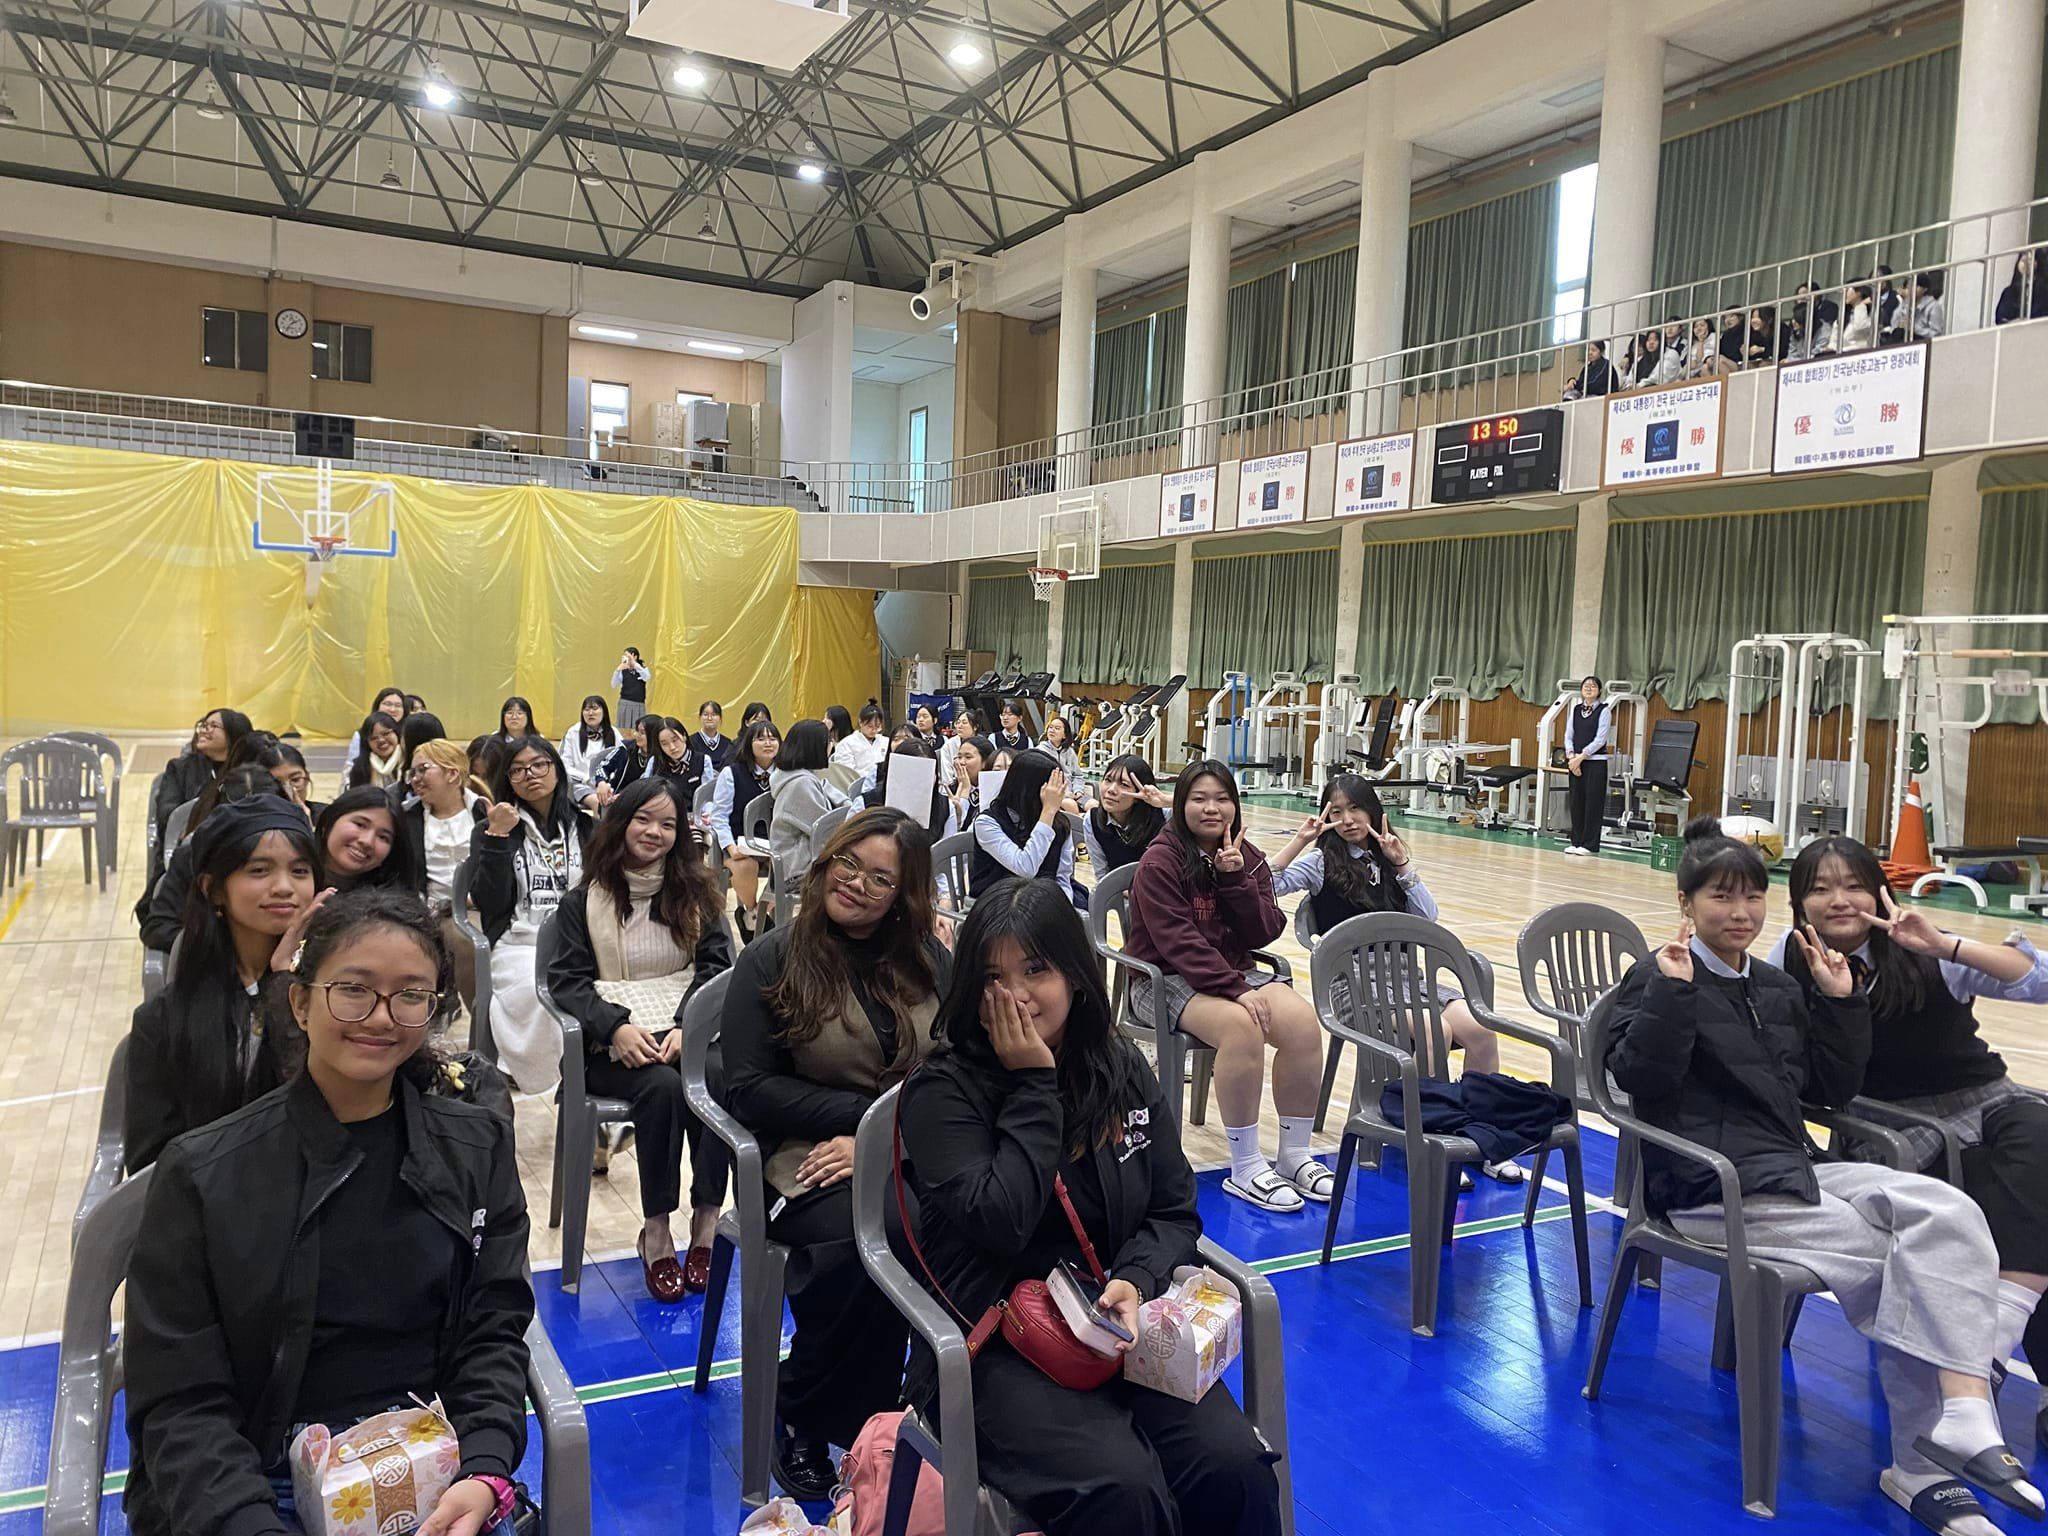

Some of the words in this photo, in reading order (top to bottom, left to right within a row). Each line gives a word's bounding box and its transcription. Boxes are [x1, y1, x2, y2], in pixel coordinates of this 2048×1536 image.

[1471, 421, 1491, 440] 13
[1498, 417, 1519, 436] 50
[1794, 415, 1812, 435] 優
[1880, 402, 1900, 423] 勝
[1621, 437, 1635, 456] 優
[1690, 426, 1705, 446] 勝
[1470, 467, 1488, 480] PLAYER
